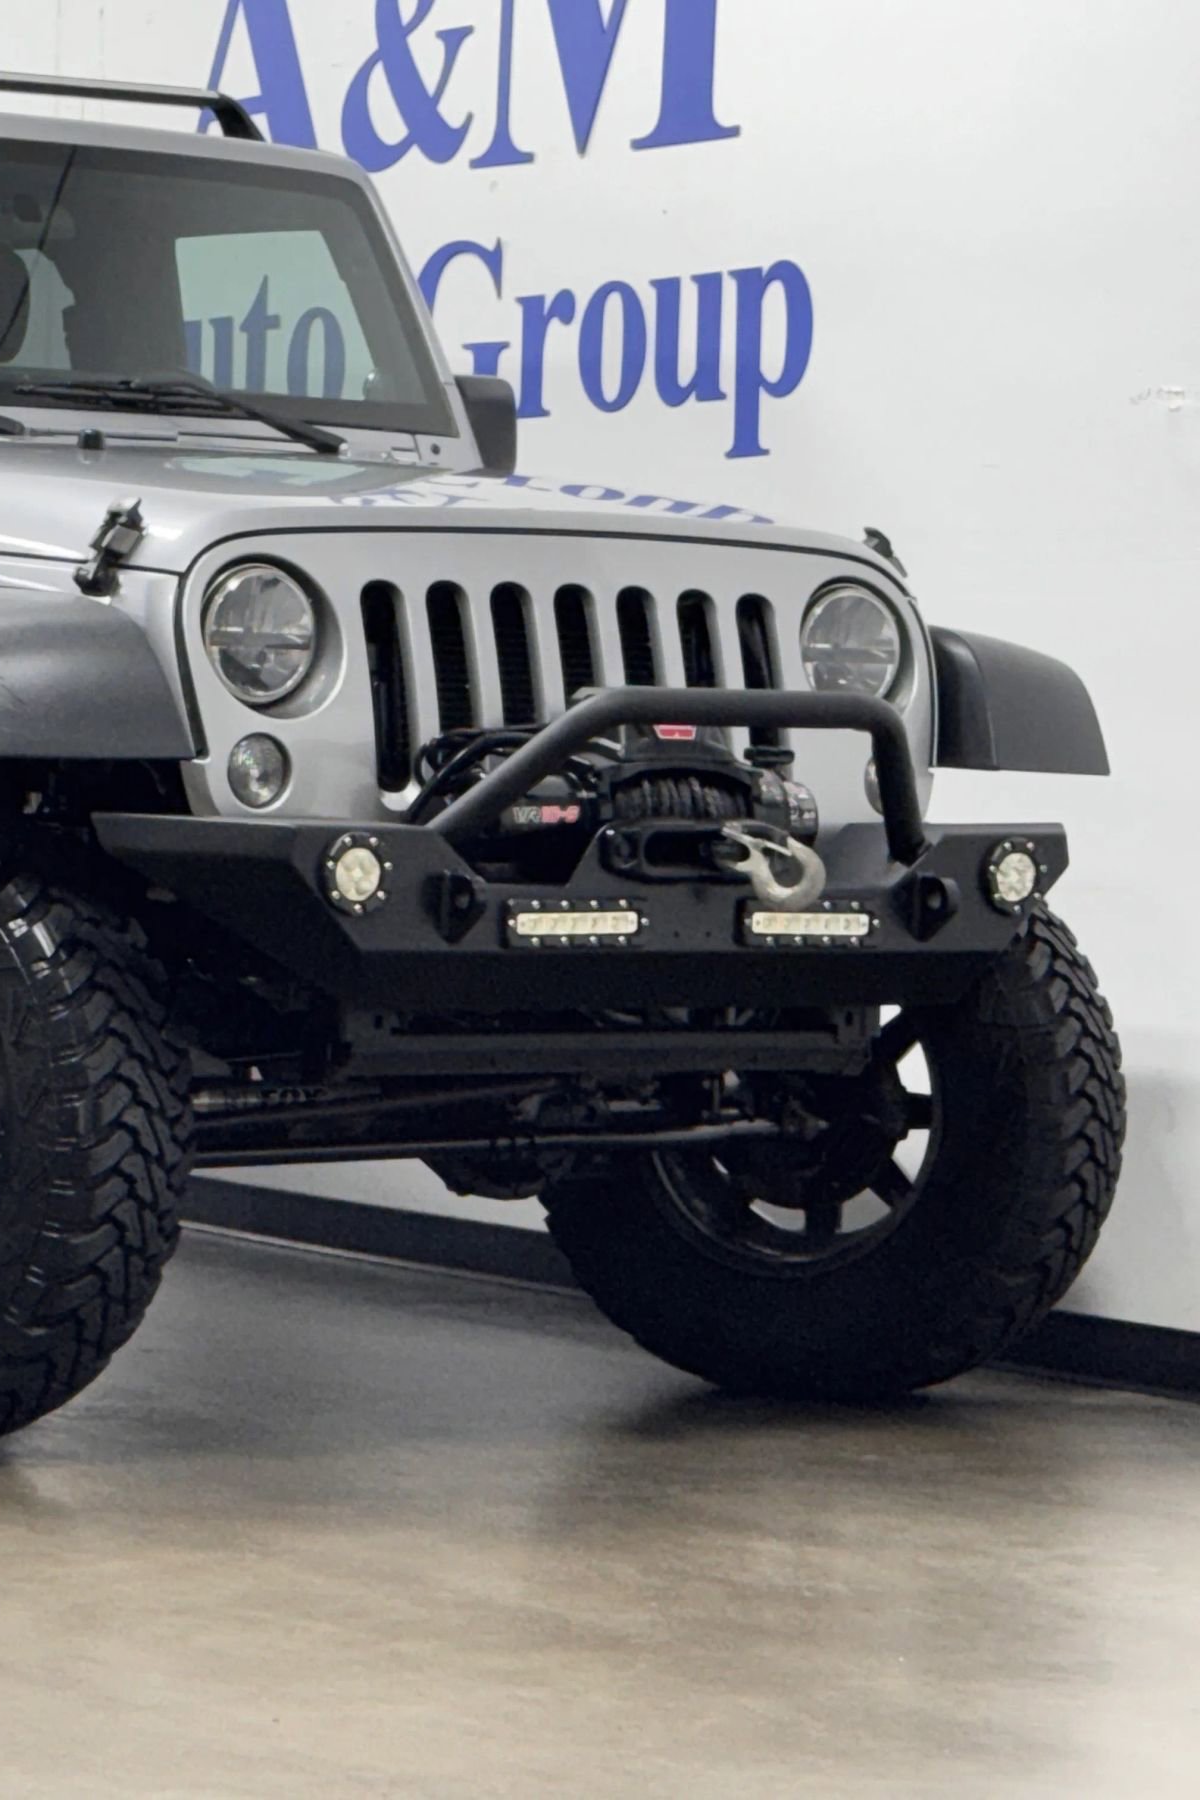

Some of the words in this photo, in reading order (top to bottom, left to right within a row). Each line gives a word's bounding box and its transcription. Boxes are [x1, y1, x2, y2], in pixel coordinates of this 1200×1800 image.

[197, 0, 741, 173] A&M
[185, 274, 346, 401] uto
[417, 236, 813, 459] Group
